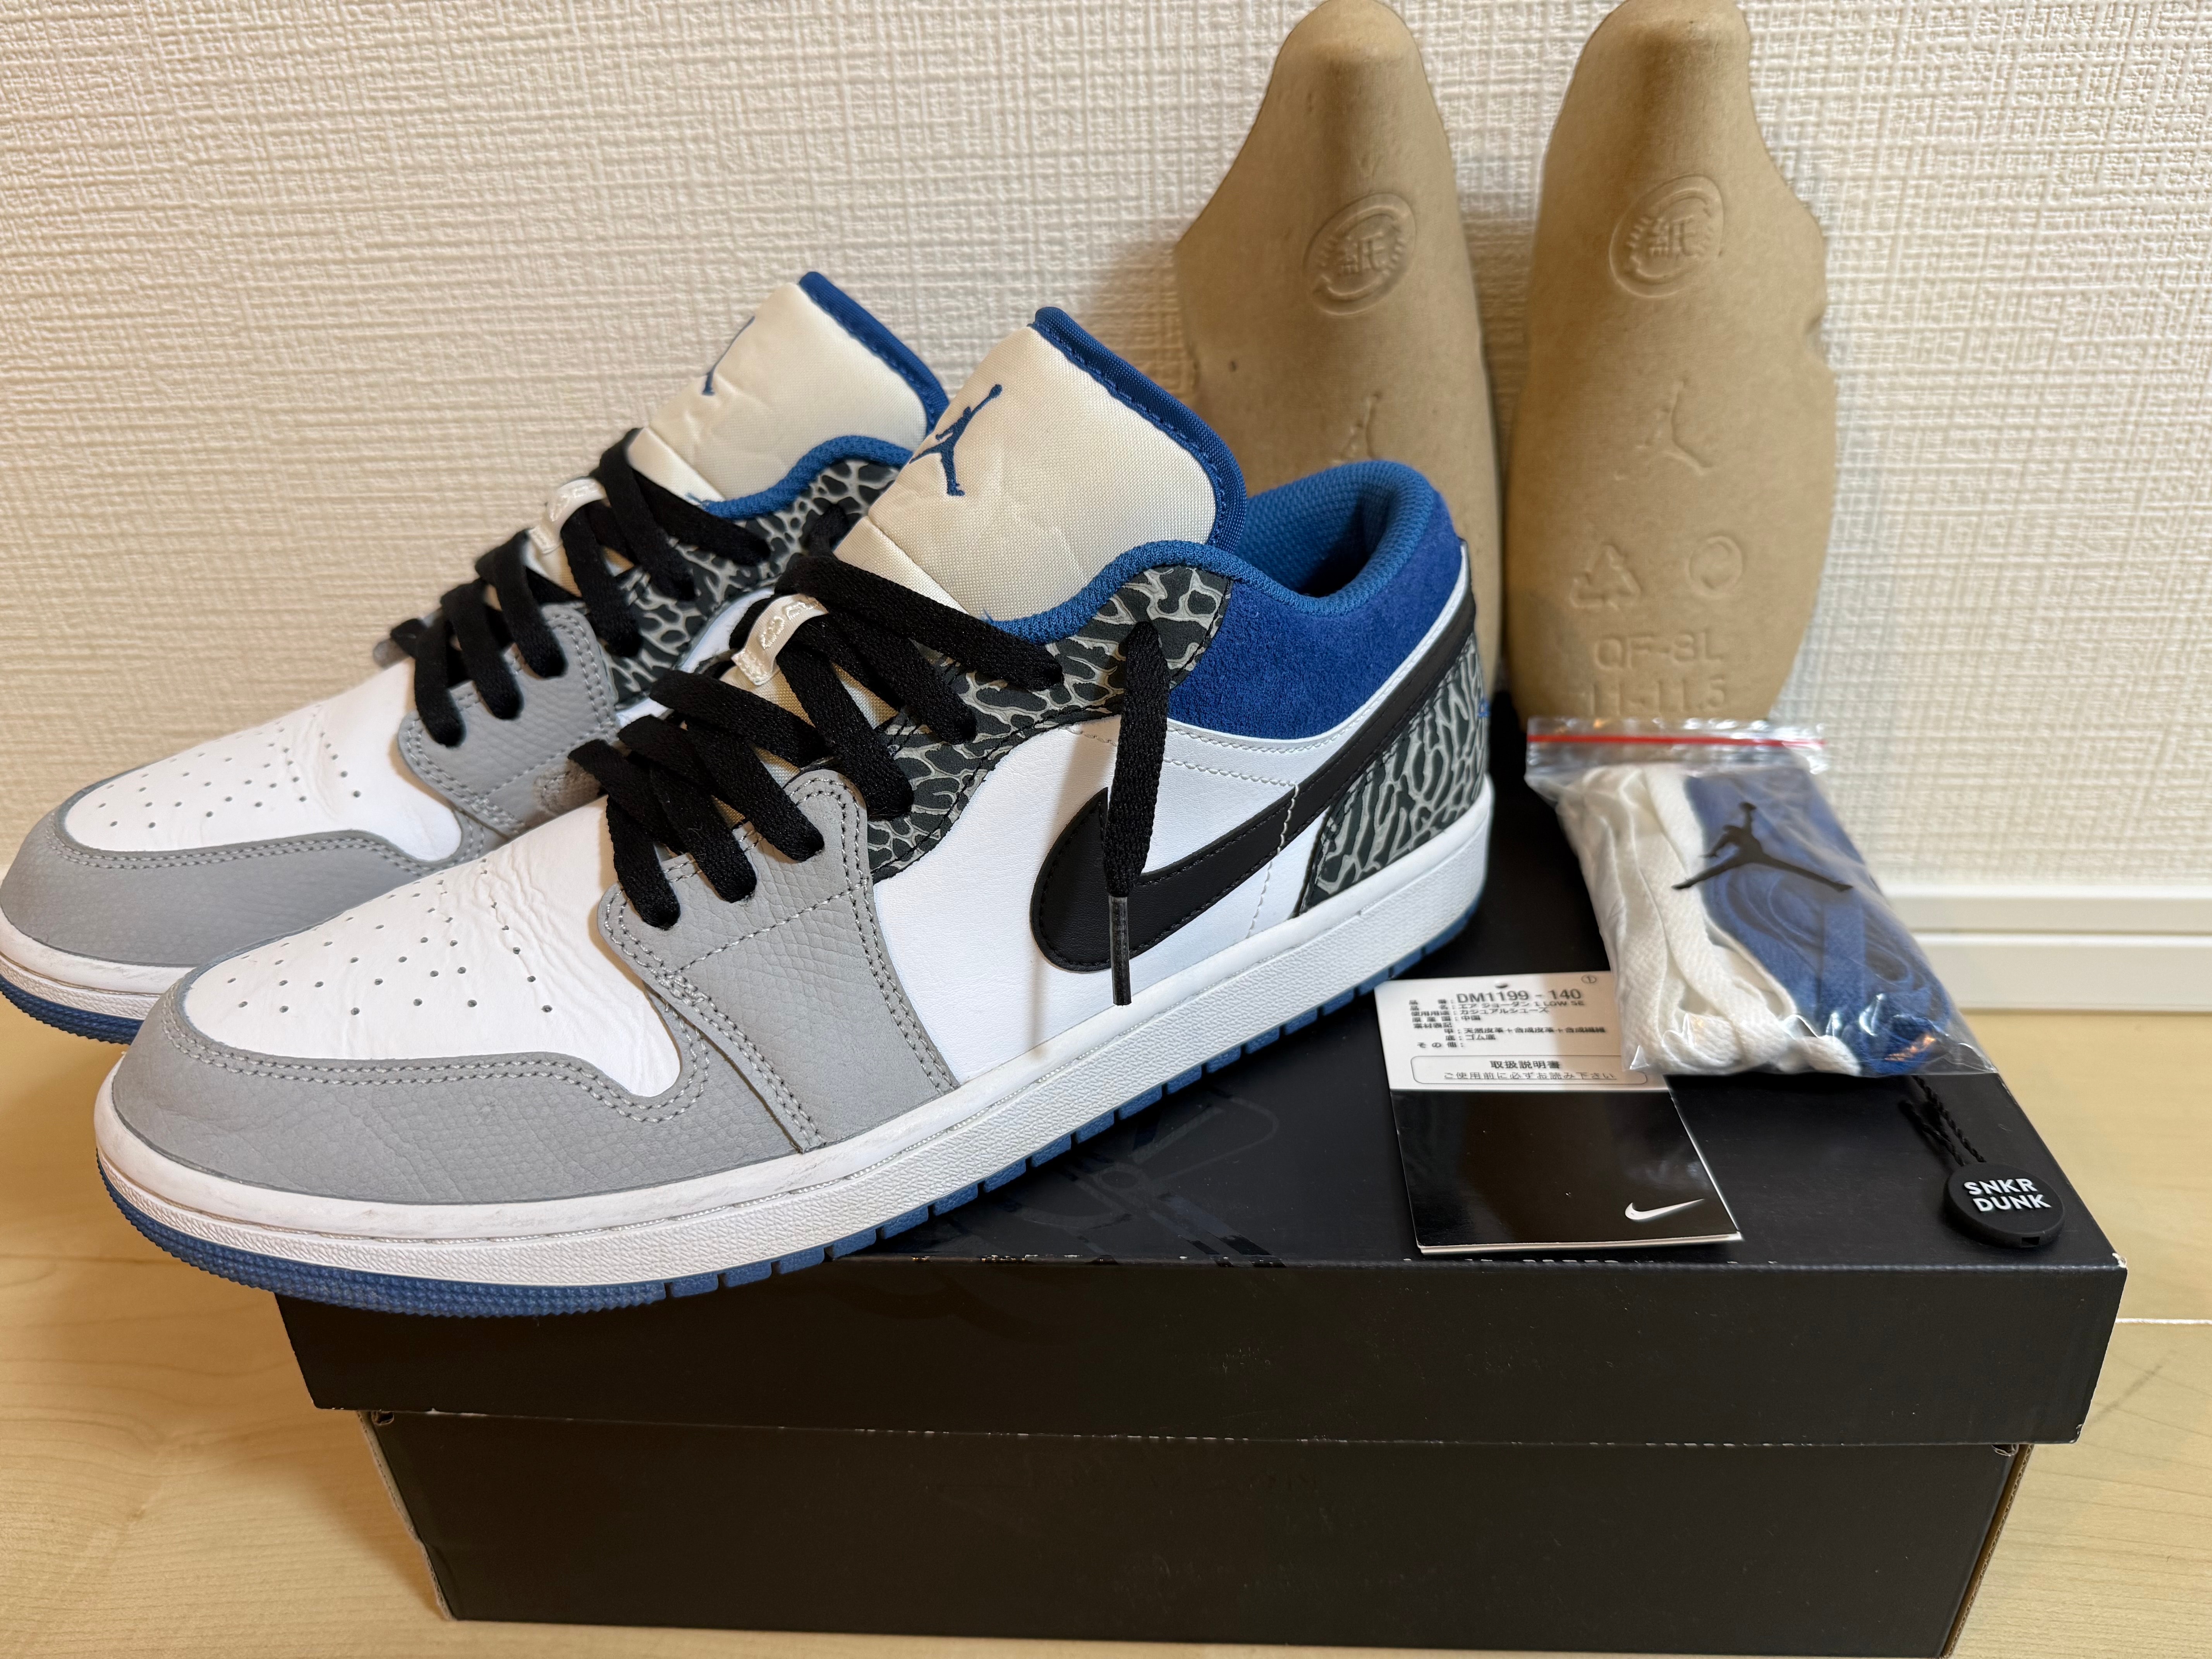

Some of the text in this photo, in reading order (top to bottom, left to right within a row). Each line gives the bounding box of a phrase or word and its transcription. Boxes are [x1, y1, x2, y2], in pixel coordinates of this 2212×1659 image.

[1456, 991, 1529, 1003] DM1199
[1549, 988, 1581, 1000] 140
[1490, 1060, 1560, 1069] 取扱説明書
[1964, 1178, 2038, 1195] SNKR
[1973, 1194, 2052, 1212] DUNK
